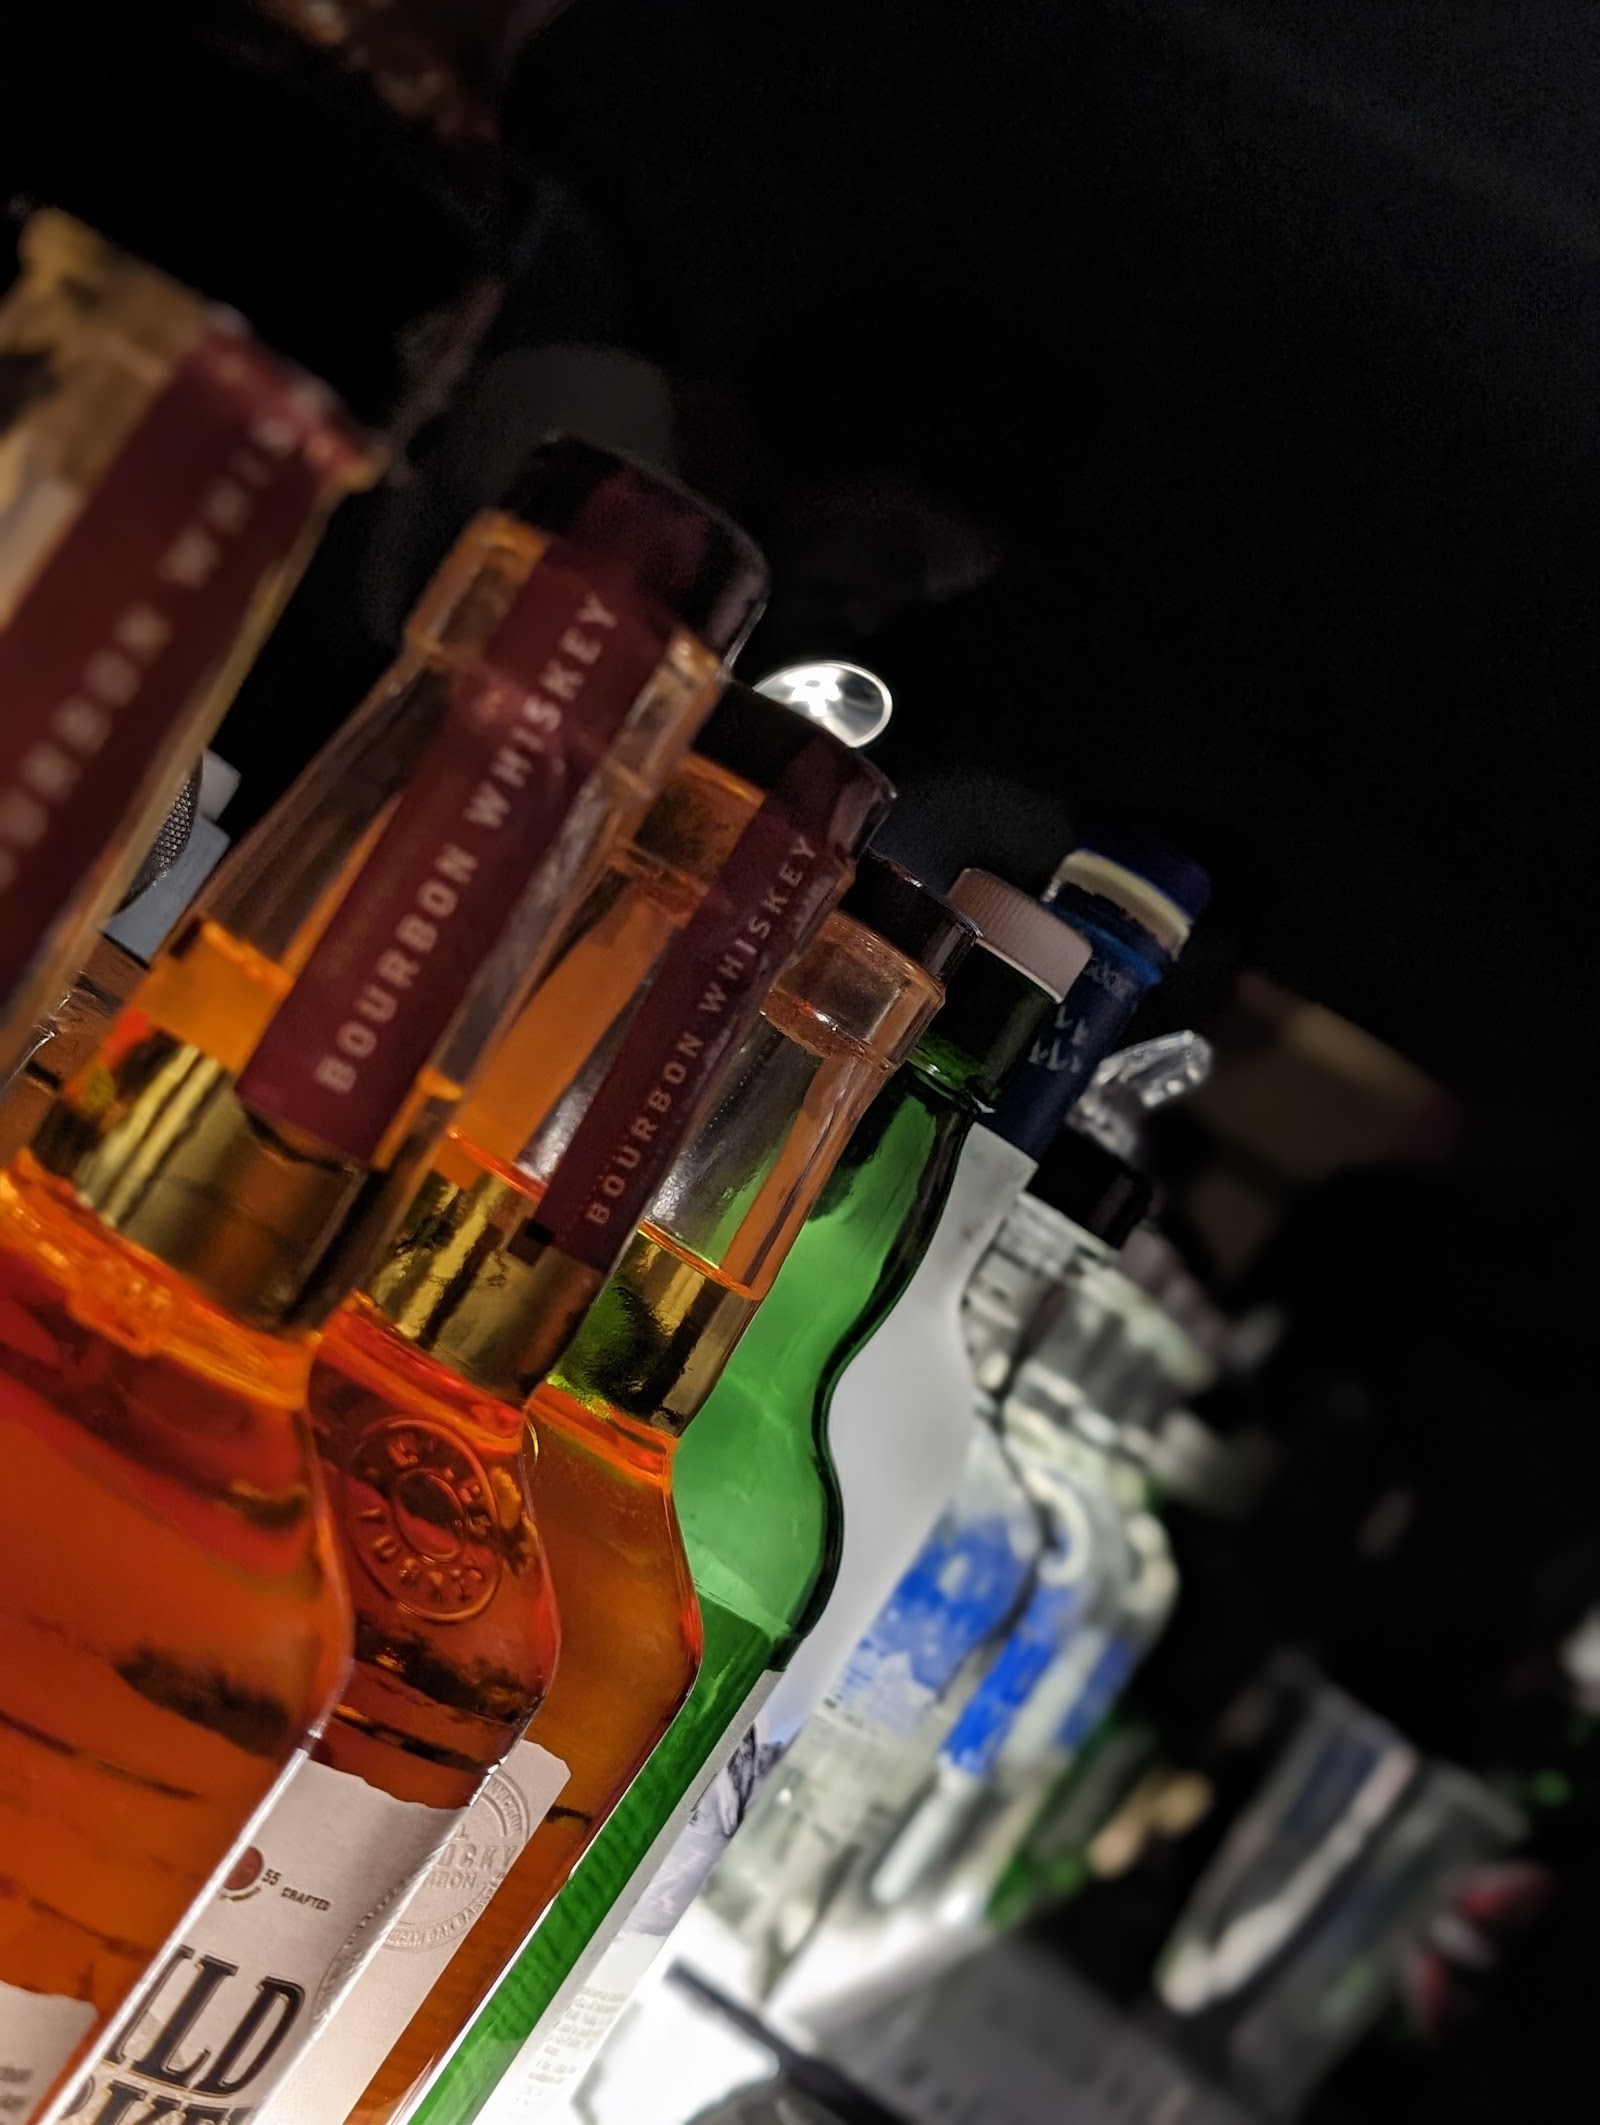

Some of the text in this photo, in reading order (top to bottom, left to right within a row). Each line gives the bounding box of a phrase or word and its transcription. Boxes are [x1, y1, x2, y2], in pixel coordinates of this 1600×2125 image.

[312, 593, 619, 1095] BOURBON WHISKEY
[586, 836, 817, 1225] BOURBON WHISKEY
[261, 1868, 283, 1886] 55
[280, 1886, 332, 1911] CRAFTED
[436, 1843, 518, 1869] UCKY
[102, 1944, 305, 2098] ILD
